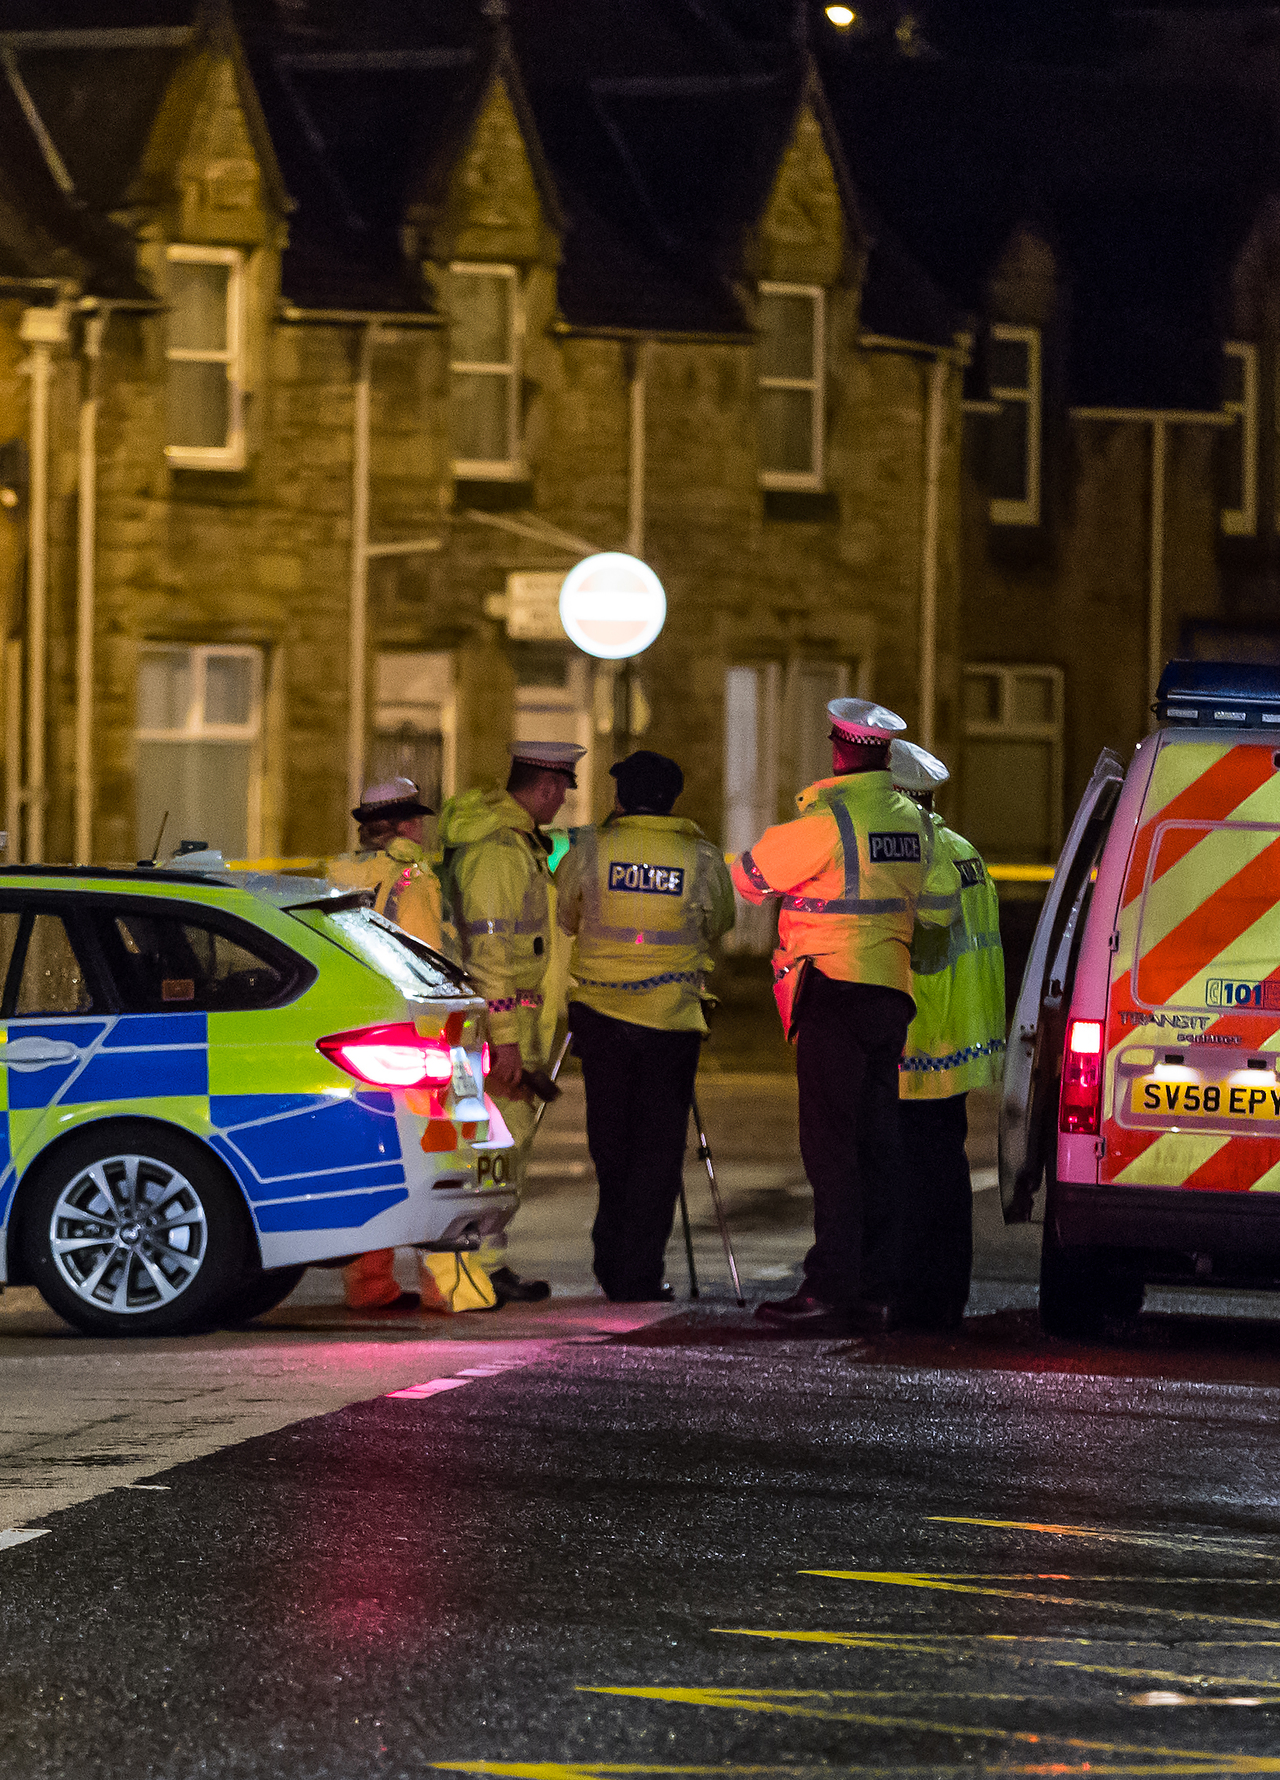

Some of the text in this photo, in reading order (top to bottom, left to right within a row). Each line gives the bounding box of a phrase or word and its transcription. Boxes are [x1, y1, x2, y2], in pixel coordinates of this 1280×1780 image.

[870, 837, 920, 858] POLICE
[612, 866, 680, 891] POLICE
[1223, 983, 1262, 1005] 101
[1143, 1083, 1221, 1113] SV58
